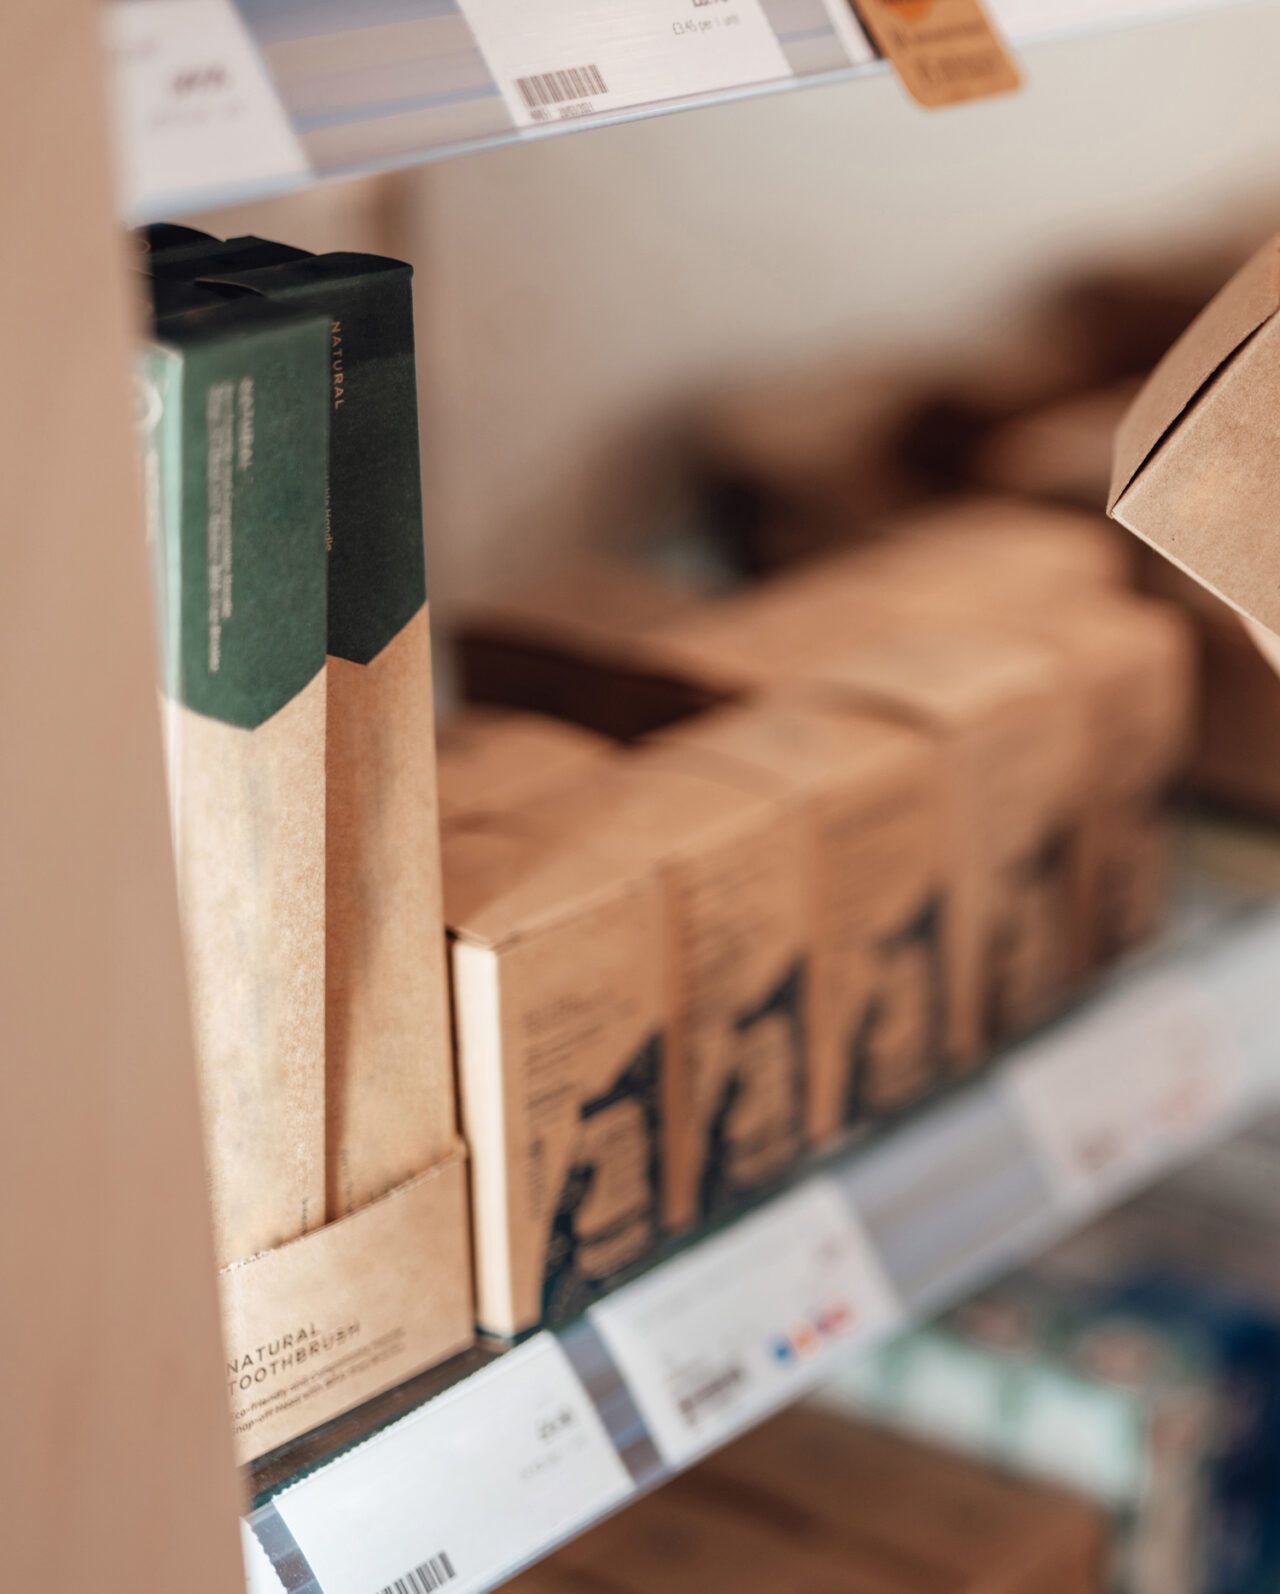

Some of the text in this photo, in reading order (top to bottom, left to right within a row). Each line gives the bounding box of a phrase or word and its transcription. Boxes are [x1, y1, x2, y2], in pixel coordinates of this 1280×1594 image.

[331, 320, 345, 411] NATURAL
[226, 1321, 319, 1377] NATURAL
[227, 1322, 361, 1396] TOOTHBRUSH
